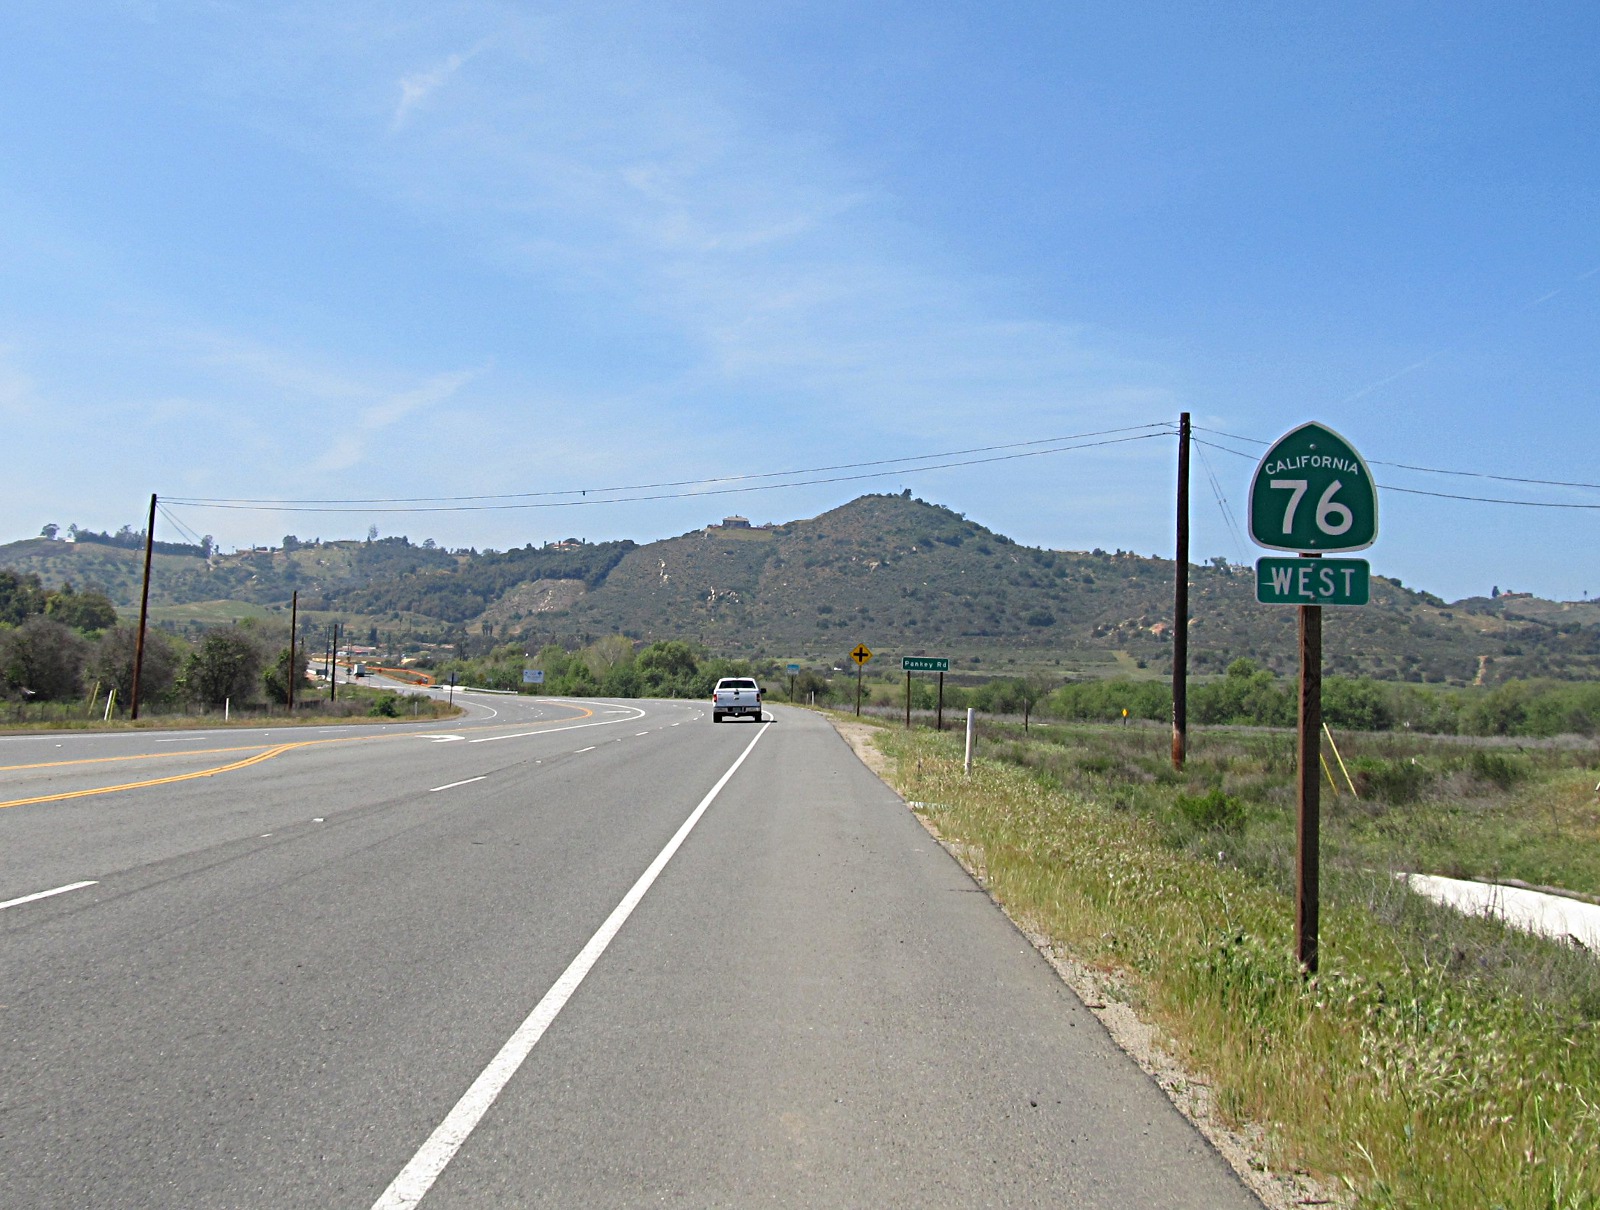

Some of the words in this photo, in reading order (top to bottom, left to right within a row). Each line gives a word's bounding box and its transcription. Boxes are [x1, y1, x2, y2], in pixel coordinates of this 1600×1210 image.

[1265, 455, 1358, 475] CALIFORNIA
[1270, 479, 1353, 535] 76
[1271, 567, 1355, 597] WEST
[904, 660, 933, 668] Pankey
